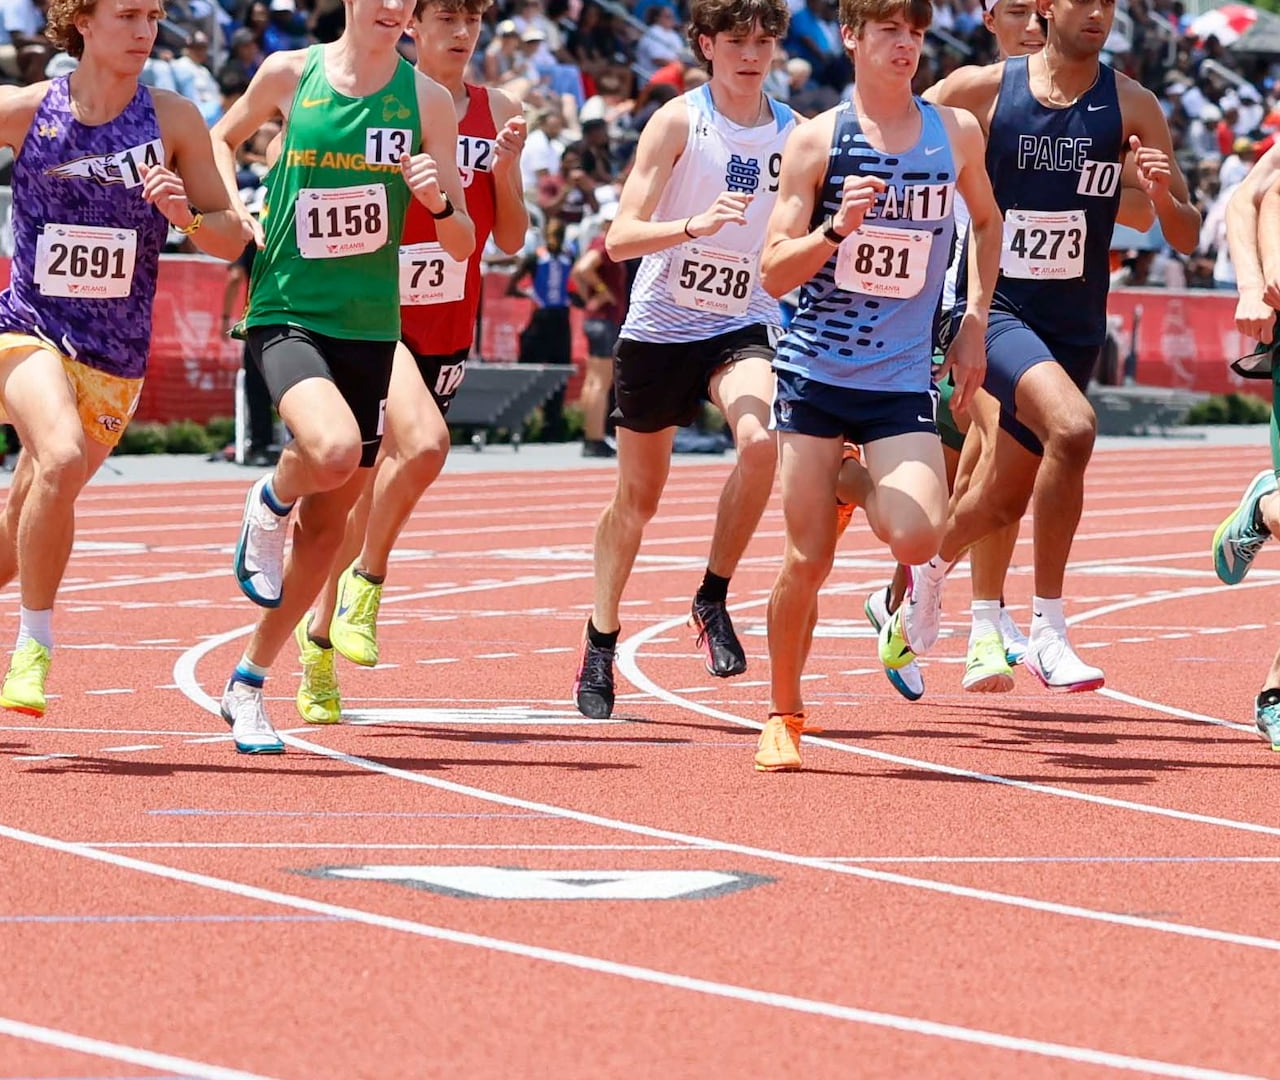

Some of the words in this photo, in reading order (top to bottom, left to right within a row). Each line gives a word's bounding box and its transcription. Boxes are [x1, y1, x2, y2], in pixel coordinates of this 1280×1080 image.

[287, 149, 317, 167] THE
[369, 129, 406, 164] 13
[459, 137, 491, 171] 12
[1018, 134, 1093, 173] PACE
[1085, 163, 1115, 195] 10
[917, 185, 948, 219] 11
[307, 202, 382, 239] 1158
[48, 243, 126, 279] 2691
[854, 242, 911, 280] 831
[1010, 228, 1082, 261] 4273
[410, 258, 445, 289] 73
[679, 258, 751, 300] 5238
